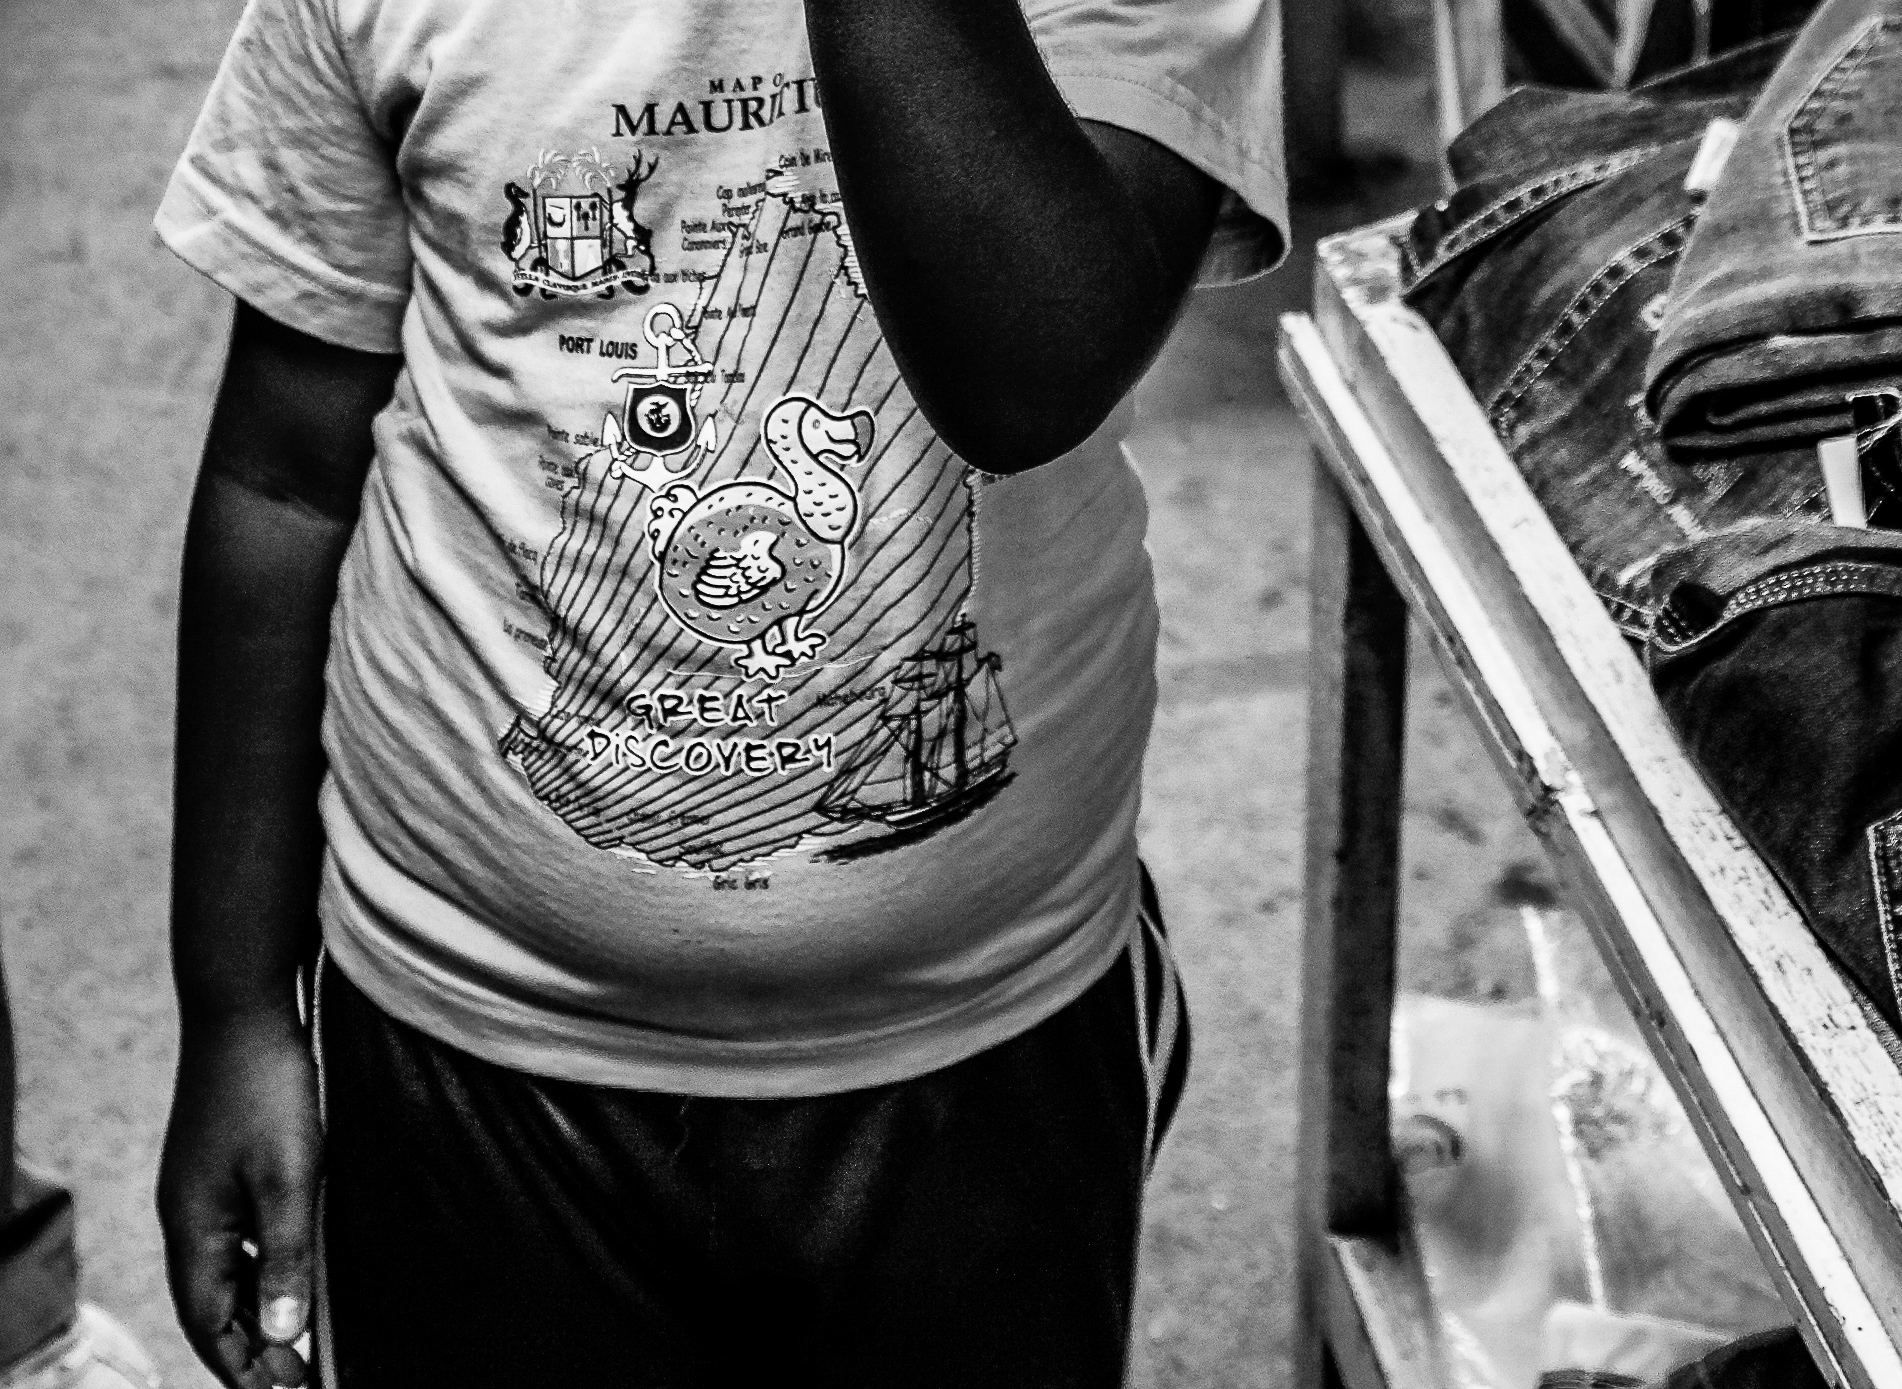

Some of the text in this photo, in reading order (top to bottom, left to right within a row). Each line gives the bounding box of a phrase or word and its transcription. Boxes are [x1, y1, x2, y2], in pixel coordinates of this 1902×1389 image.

[708, 72, 786, 95] MAP O
[611, 76, 824, 138] MAURITI
[558, 334, 639, 361] PORT LOUIS
[625, 691, 787, 733] GREAT
